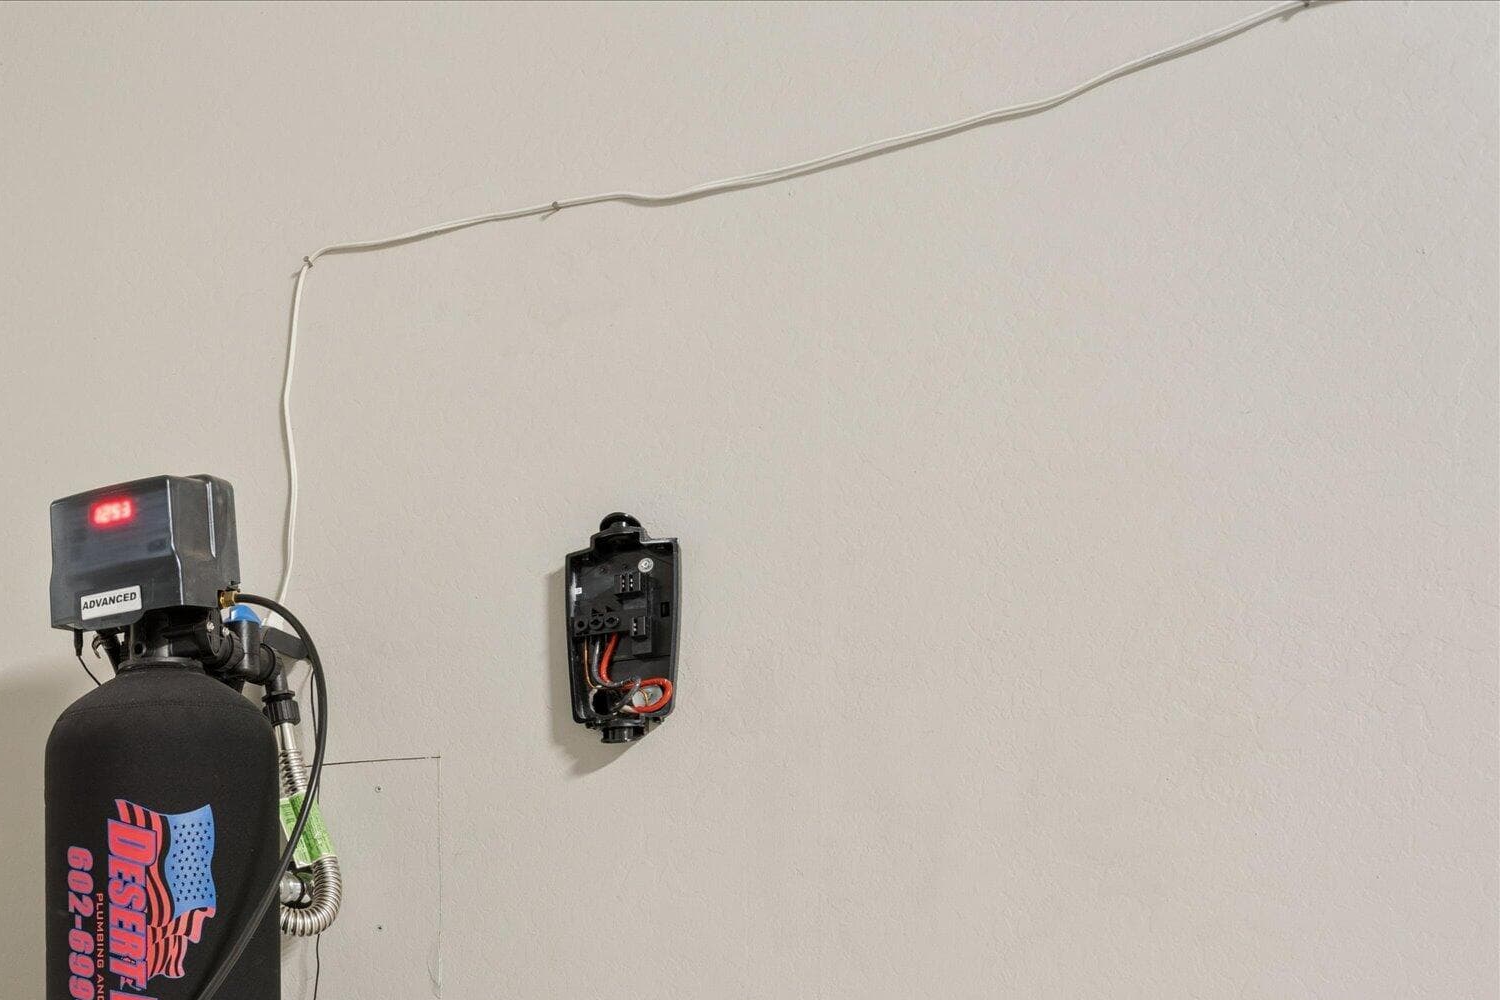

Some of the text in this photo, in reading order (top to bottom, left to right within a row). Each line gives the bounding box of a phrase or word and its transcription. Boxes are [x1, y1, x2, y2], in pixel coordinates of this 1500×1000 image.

[82, 591, 137, 610] ADVANCED
[96, 892, 105, 969] PLUMBING
[107, 818, 157, 990] DESERT
